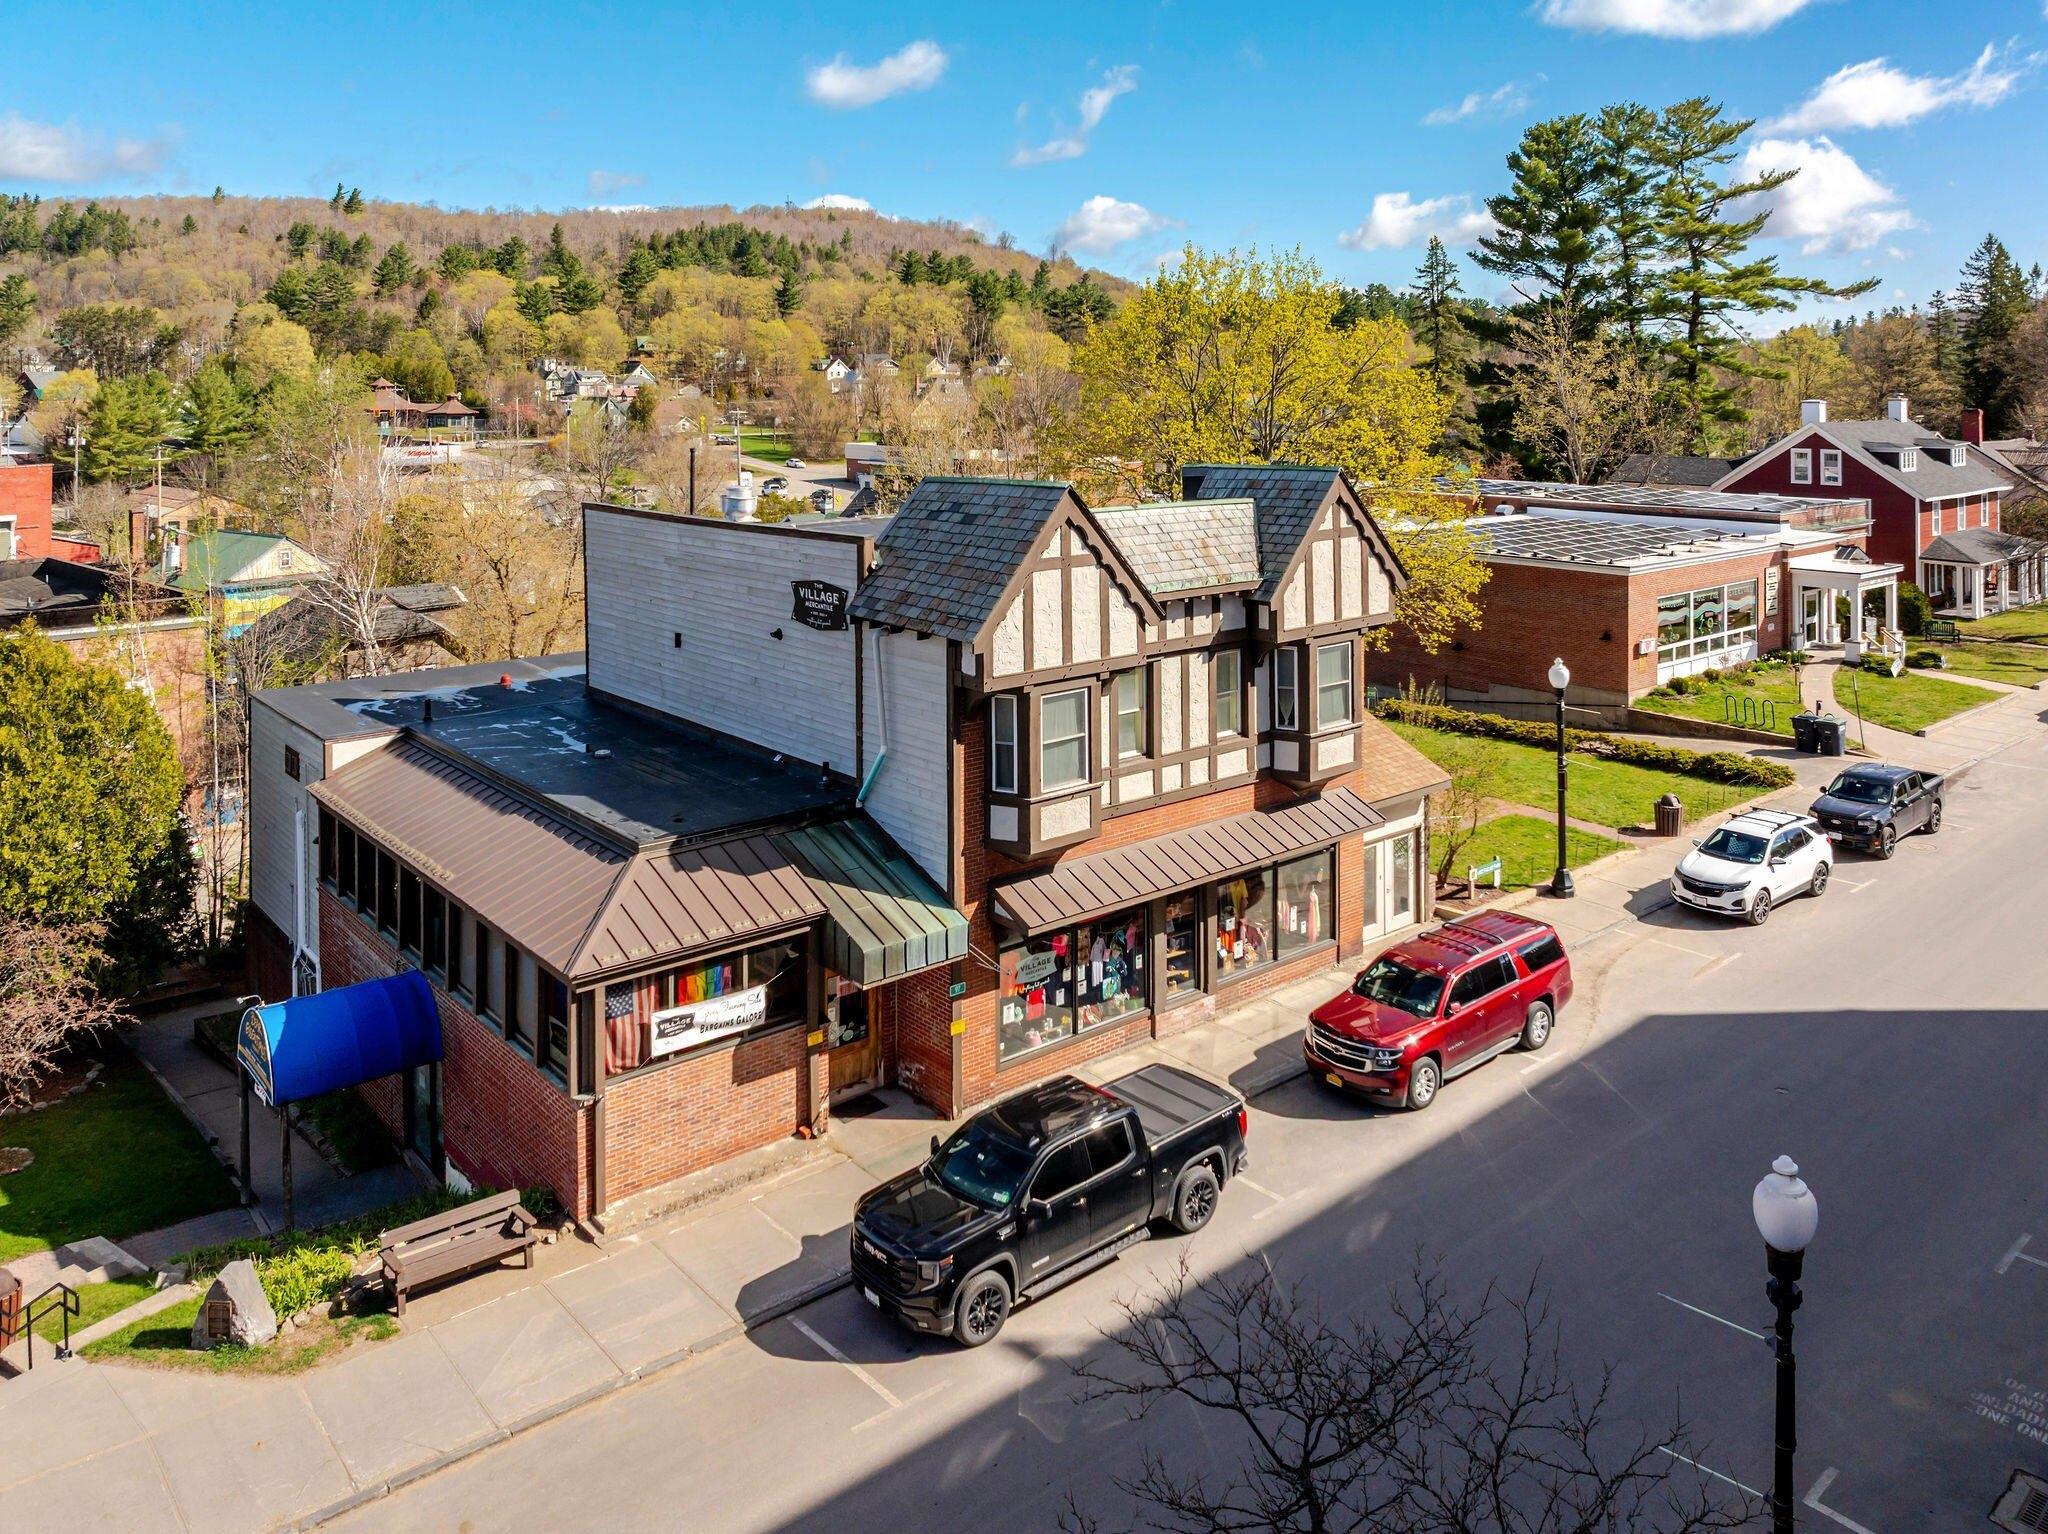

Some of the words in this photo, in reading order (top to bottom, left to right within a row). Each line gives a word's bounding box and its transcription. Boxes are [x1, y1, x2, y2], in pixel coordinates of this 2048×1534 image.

[799, 587, 839, 605] VILLAGE
[805, 601, 833, 611] MERCANTILE
[1020, 956, 1051, 972] VILLAGE
[660, 1017, 691, 1030] VILLAGE
[700, 1018, 734, 1034] BARGAINS
[736, 1010, 762, 1025] GALORE
[863, 1240, 887, 1264] GMC
